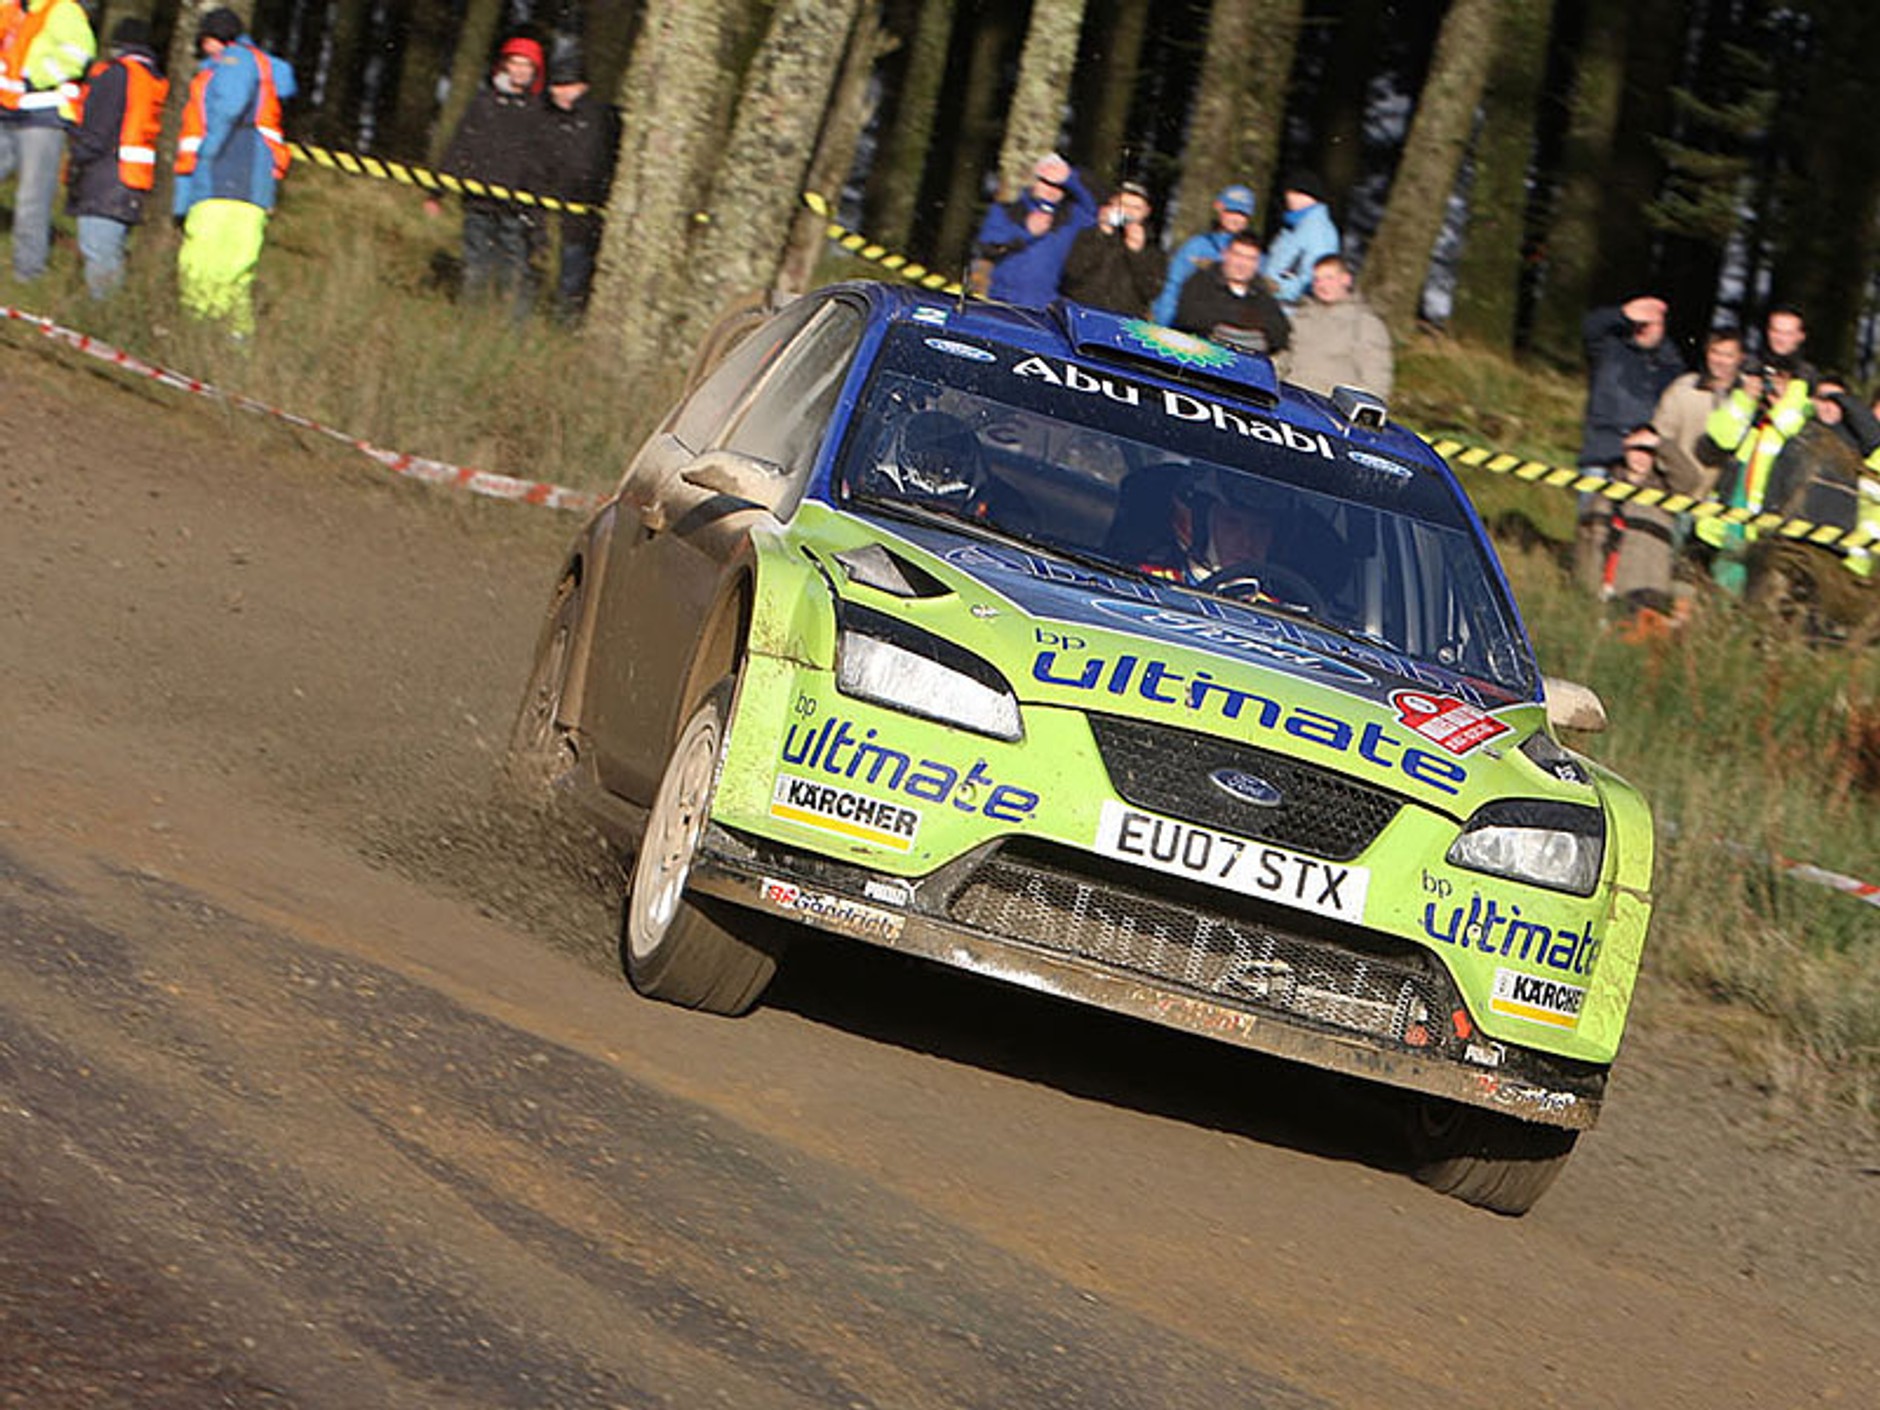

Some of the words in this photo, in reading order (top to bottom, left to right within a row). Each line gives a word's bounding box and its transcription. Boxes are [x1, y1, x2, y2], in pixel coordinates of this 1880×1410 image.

[1012, 357, 1139, 406] Abu
[1035, 627, 1086, 650] bp
[794, 690, 817, 720] bp
[1033, 650, 1468, 796] ultimate
[782, 716, 1040, 823] ultimate
[788, 779, 918, 836] KÄRCHER
[1117, 812, 1246, 879] EU07
[1256, 849, 1349, 911] STX
[1422, 868, 1453, 898] bp
